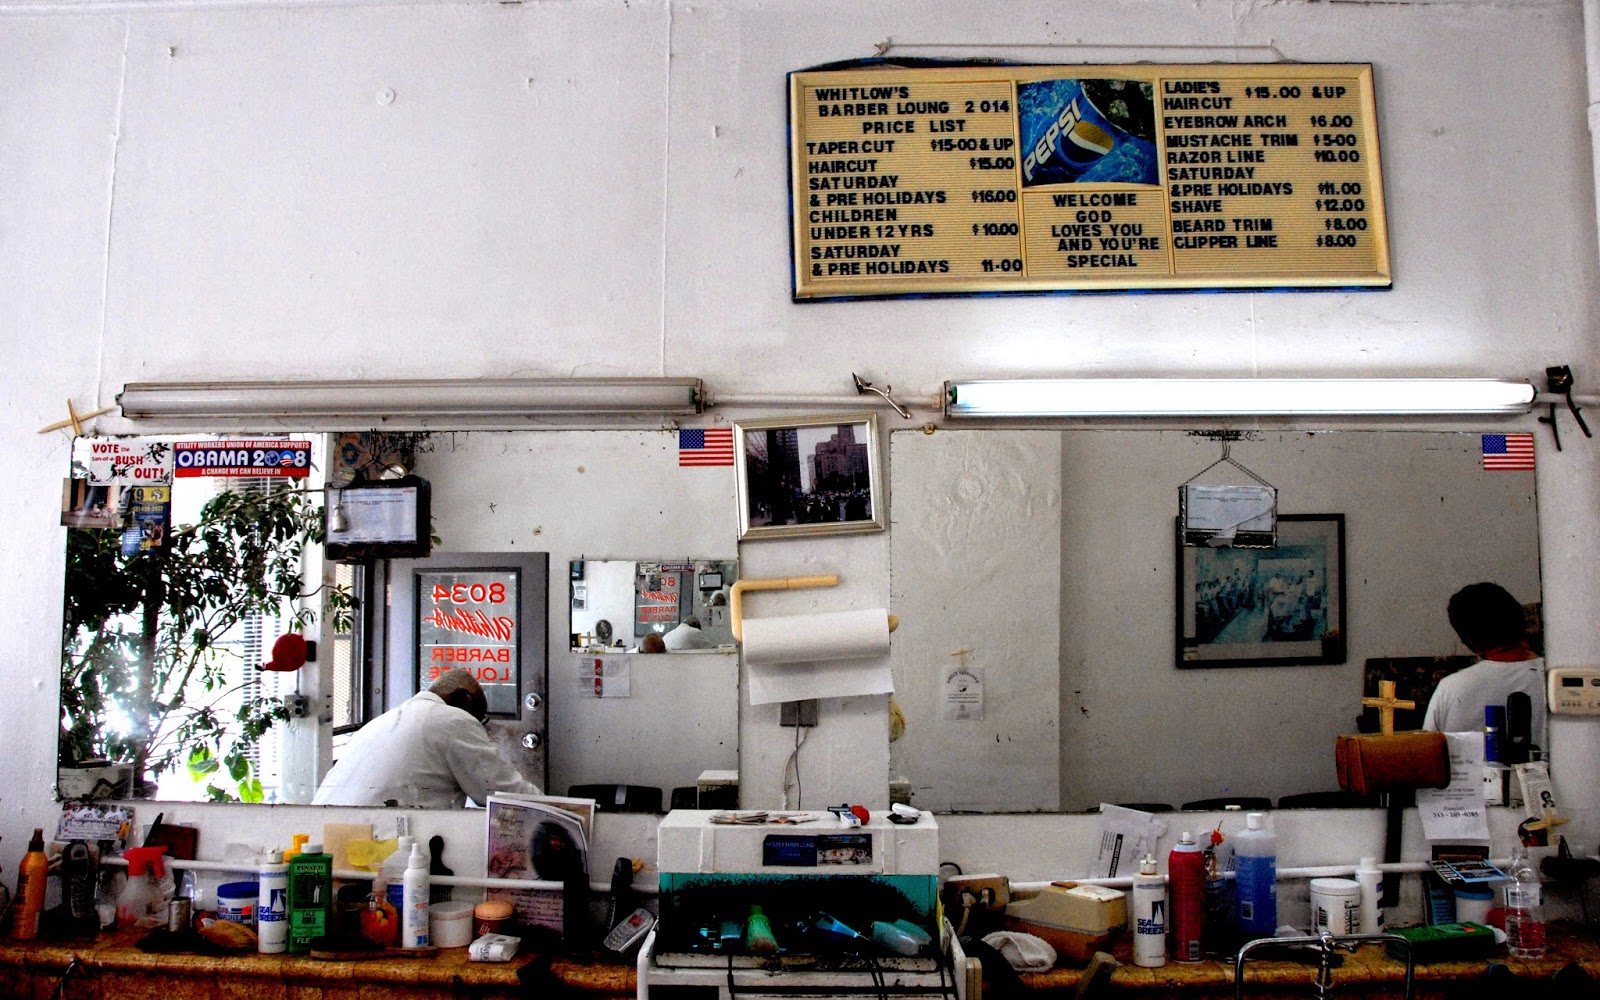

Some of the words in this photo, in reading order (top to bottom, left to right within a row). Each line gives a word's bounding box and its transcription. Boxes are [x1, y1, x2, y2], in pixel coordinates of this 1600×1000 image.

[815, 86, 909, 100] WHITLOW'S
[1165, 81, 1220, 94] LADIE'S
[1245, 87, 1300, 98] $15.00
[819, 104, 888, 117] BARBER
[897, 102, 949, 114] LOUNG
[862, 121, 915, 134] PRICE
[930, 120, 966, 132] LIST
[1164, 116, 1238, 129] EYEBROW
[1243, 116, 1286, 127] ARCH
[1310, 116, 1353, 128] $6.00
[980, 138, 990, 150] &
[996, 138, 1014, 150] UP
[1023, 98, 1082, 182] PEPSI
[1167, 135, 1252, 147] MUSTACHE
[1261, 134, 1298, 146] TRIM
[806, 142, 860, 154] TAPER
[862, 140, 895, 153] CUT
[1167, 151, 1221, 163] RAZOR
[1227, 151, 1265, 162] LINE
[1315, 151, 1359, 162] $10.00
[808, 160, 877, 174] HAIRCUT
[970, 158, 1014, 170] $15.00
[1168, 167, 1255, 180] SATURDAY
[809, 176, 898, 190] SATURDAY
[1218, 183, 1293, 195] HOLIDAYS
[1317, 183, 1361, 195] $11.00
[810, 194, 820, 207] &
[827, 194, 859, 206] PRE
[863, 191, 946, 205] HOLIDAYS
[972, 190, 1016, 202] $16.00
[1053, 194, 1137, 207] WELCOME
[1171, 200, 1222, 213] SHAVE
[1315, 200, 1364, 211] $12.00
[809, 209, 897, 222] CHILDREN
[1076, 211, 1112, 223] GOD
[1052, 225, 1101, 237] LOVES
[1109, 224, 1142, 236] YOU
[1173, 220, 1225, 232] BEARD
[1232, 219, 1272, 231] TRIM
[1325, 218, 1367, 230] $8.00
[810, 226, 870, 240] UNDER
[876, 226, 894, 238] 12
[898, 224, 933, 238] YRS
[1057, 239, 1092, 251] AND
[1100, 238, 1159, 250] YOU'RE
[1174, 236, 1237, 248] CLIPPER
[1247, 235, 1277, 248] LINE
[1316, 235, 1356, 247] $8.00
[811, 244, 900, 258] SATURDAY
[1067, 255, 1137, 267] SPECIAL
[812, 263, 822, 276] &
[828, 262, 860, 276] PRE
[866, 260, 949, 274] HOLIDAYS
[92, 444, 119, 453] VOTE
[115, 456, 143, 465] BUSH
[178, 450, 248, 467] OBAMA
[135, 468, 164, 479] OUT!
[259, 906, 271, 914] SEA
[259, 913, 287, 922] BREEZE
[1138, 918, 1152, 926] SEA
[1137, 926, 1164, 934] BREEZE
